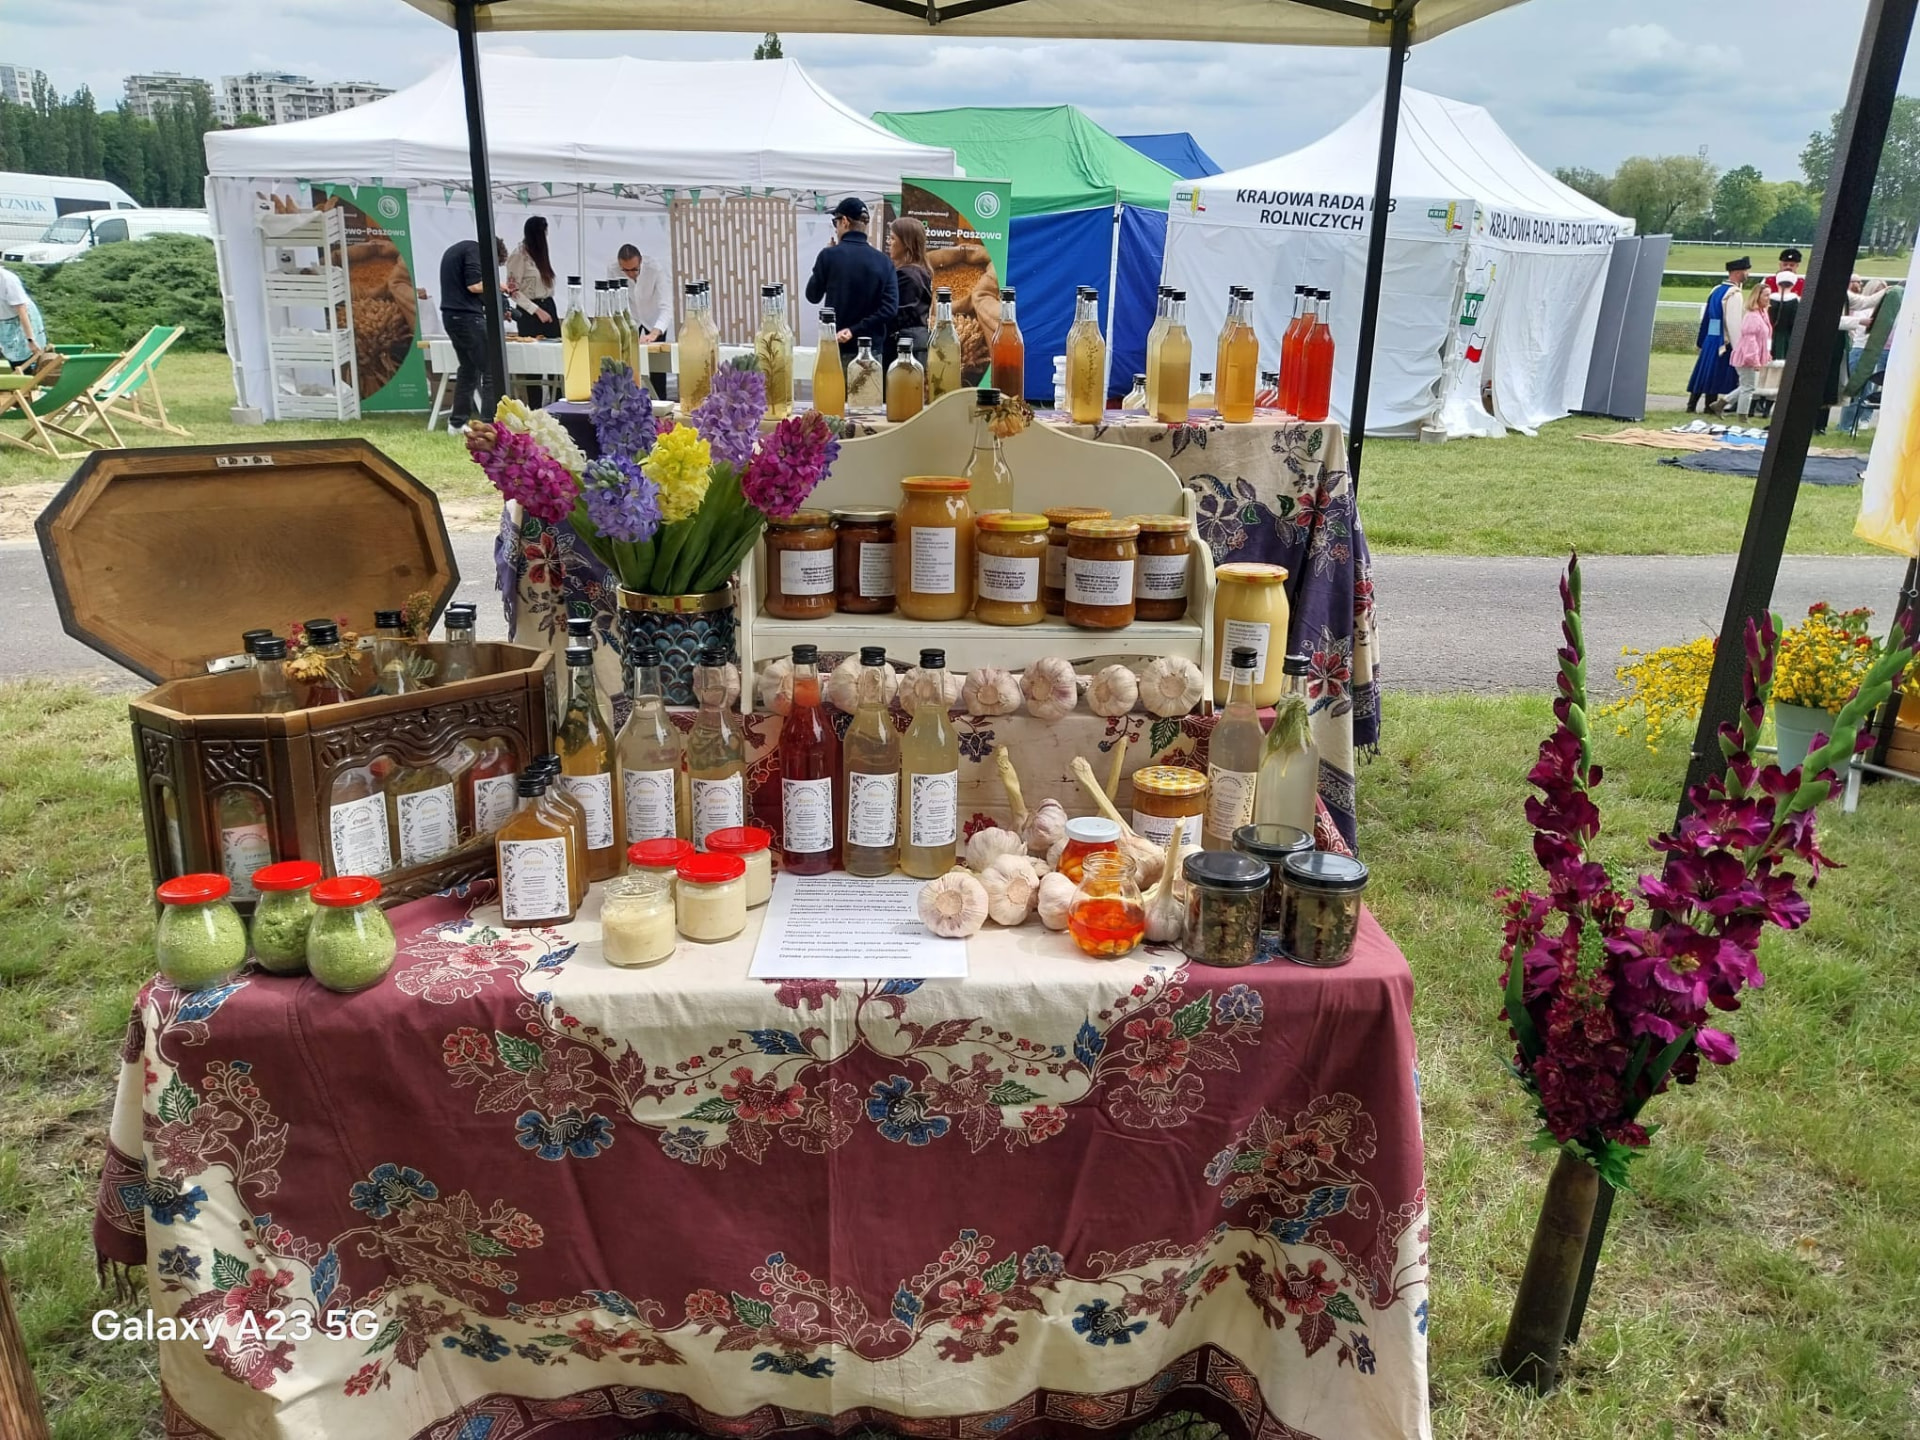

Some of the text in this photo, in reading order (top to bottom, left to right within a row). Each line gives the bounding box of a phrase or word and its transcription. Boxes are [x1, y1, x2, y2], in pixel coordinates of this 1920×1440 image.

[1236, 189, 1397, 213] KRAJOWA RADA IB
[1260, 209, 1365, 231] ROLNICZYCH
[1534, 219, 1555, 243] RADA
[1557, 222, 1570, 245] IZB
[1572, 223, 1619, 246] ROLNICZYCH
